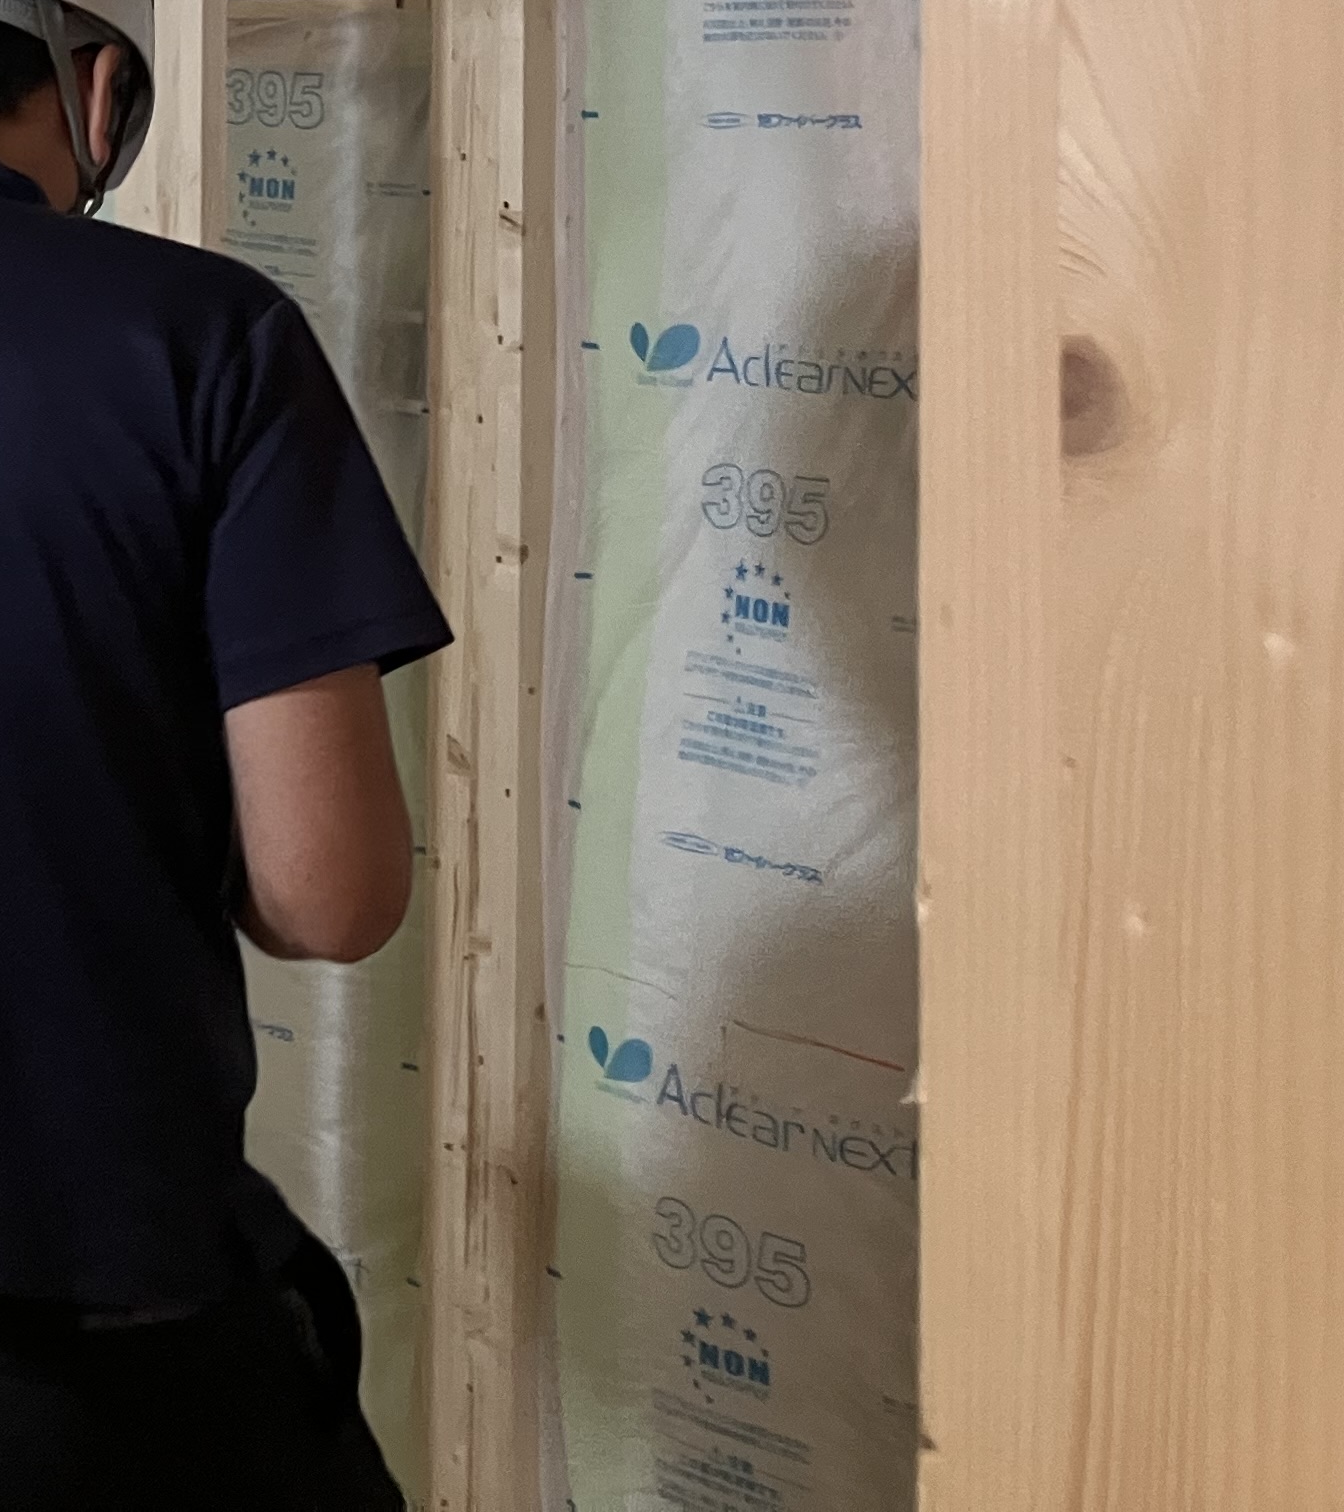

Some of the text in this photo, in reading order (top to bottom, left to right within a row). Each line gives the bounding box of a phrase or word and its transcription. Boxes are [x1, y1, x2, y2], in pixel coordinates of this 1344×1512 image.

[226, 69, 325, 129] 395
[249, 178, 295, 200] NON
[701, 463, 831, 545] 395
[734, 594, 790, 628] NON
[653, 1196, 810, 1308] 395
[698, 1340, 770, 1386] NON
